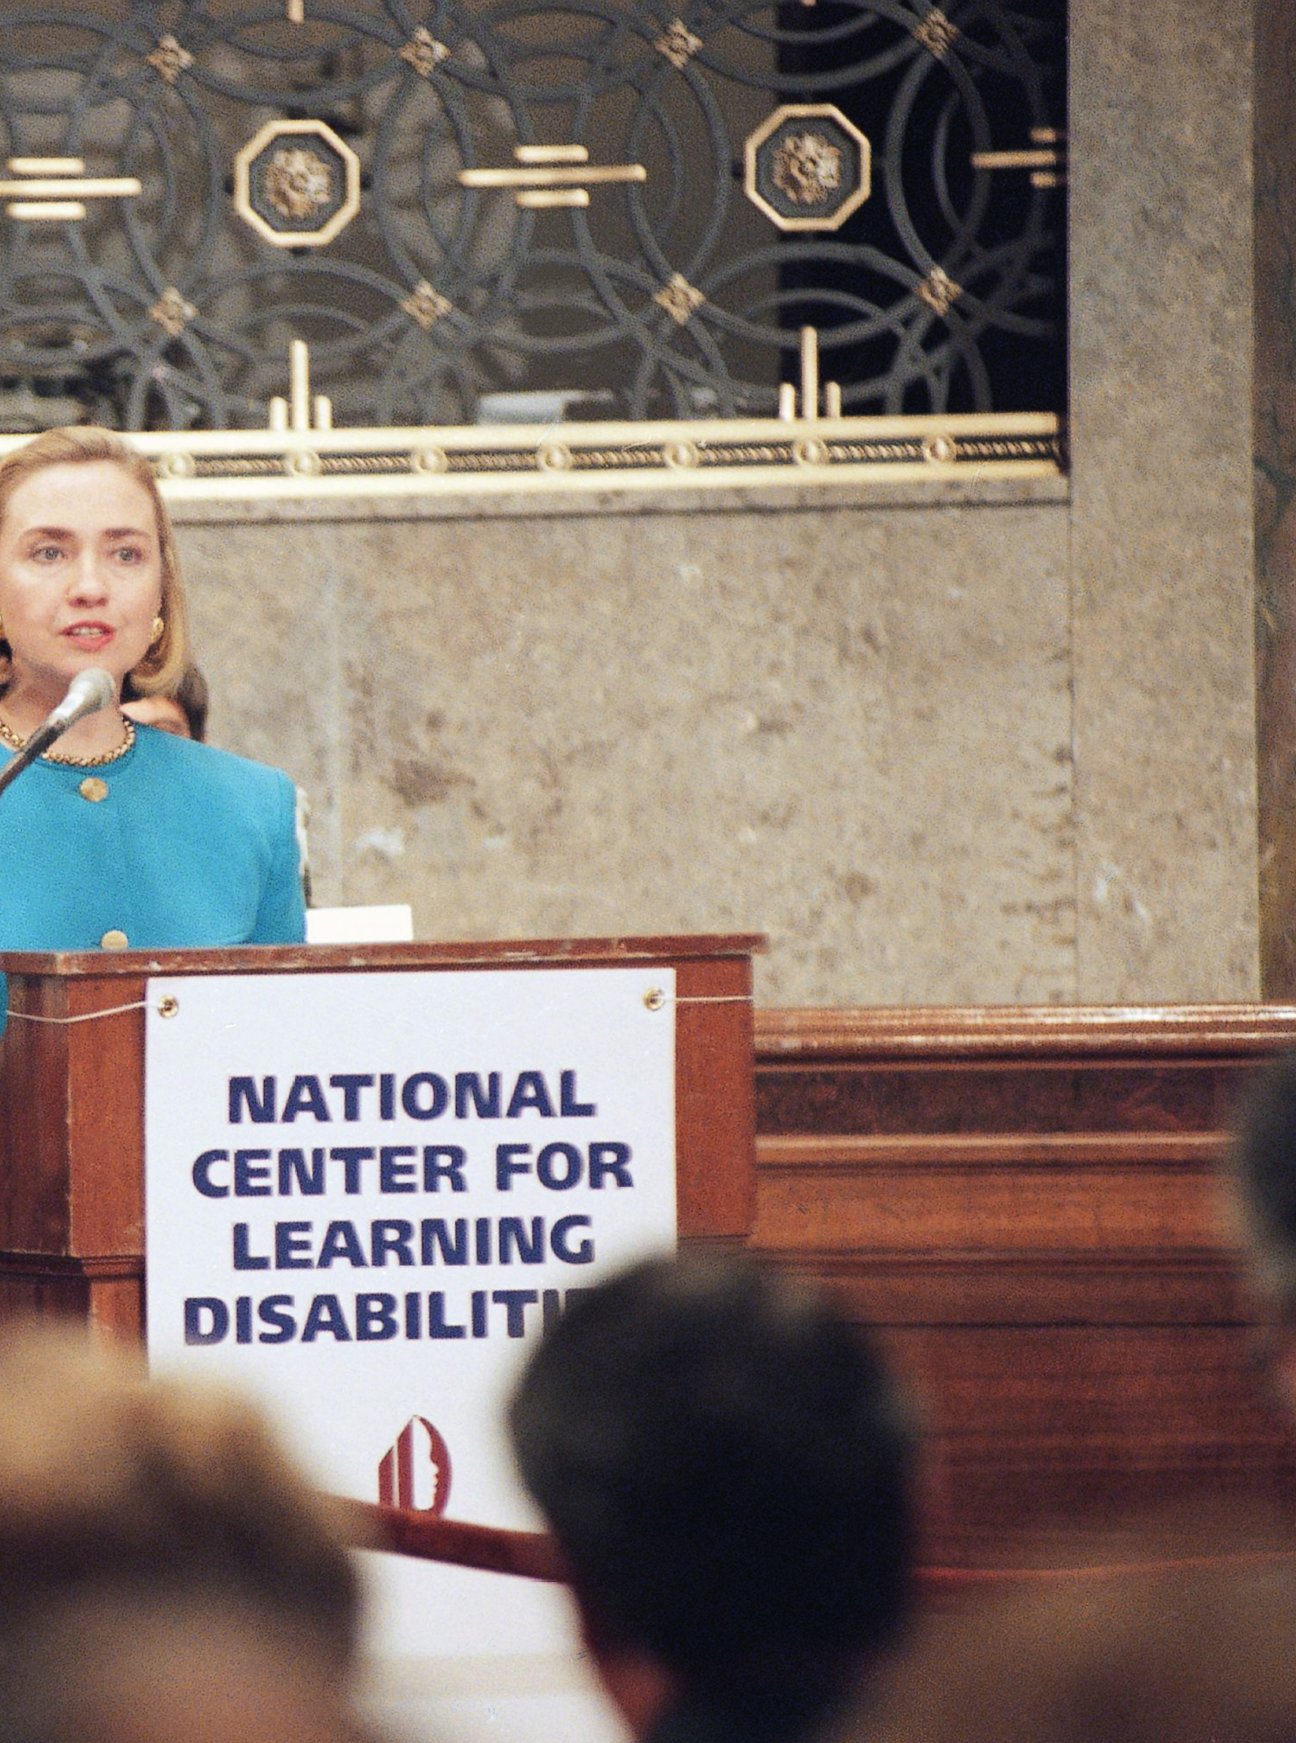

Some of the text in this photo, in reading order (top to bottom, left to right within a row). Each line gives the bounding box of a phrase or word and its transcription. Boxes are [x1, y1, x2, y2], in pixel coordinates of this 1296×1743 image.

[228, 1070, 595, 1123] NATIONAL
[192, 1142, 633, 1197] CENTER FOR
[233, 1215, 595, 1270] LEARNING
[184, 1289, 586, 1345] DISABILITI
